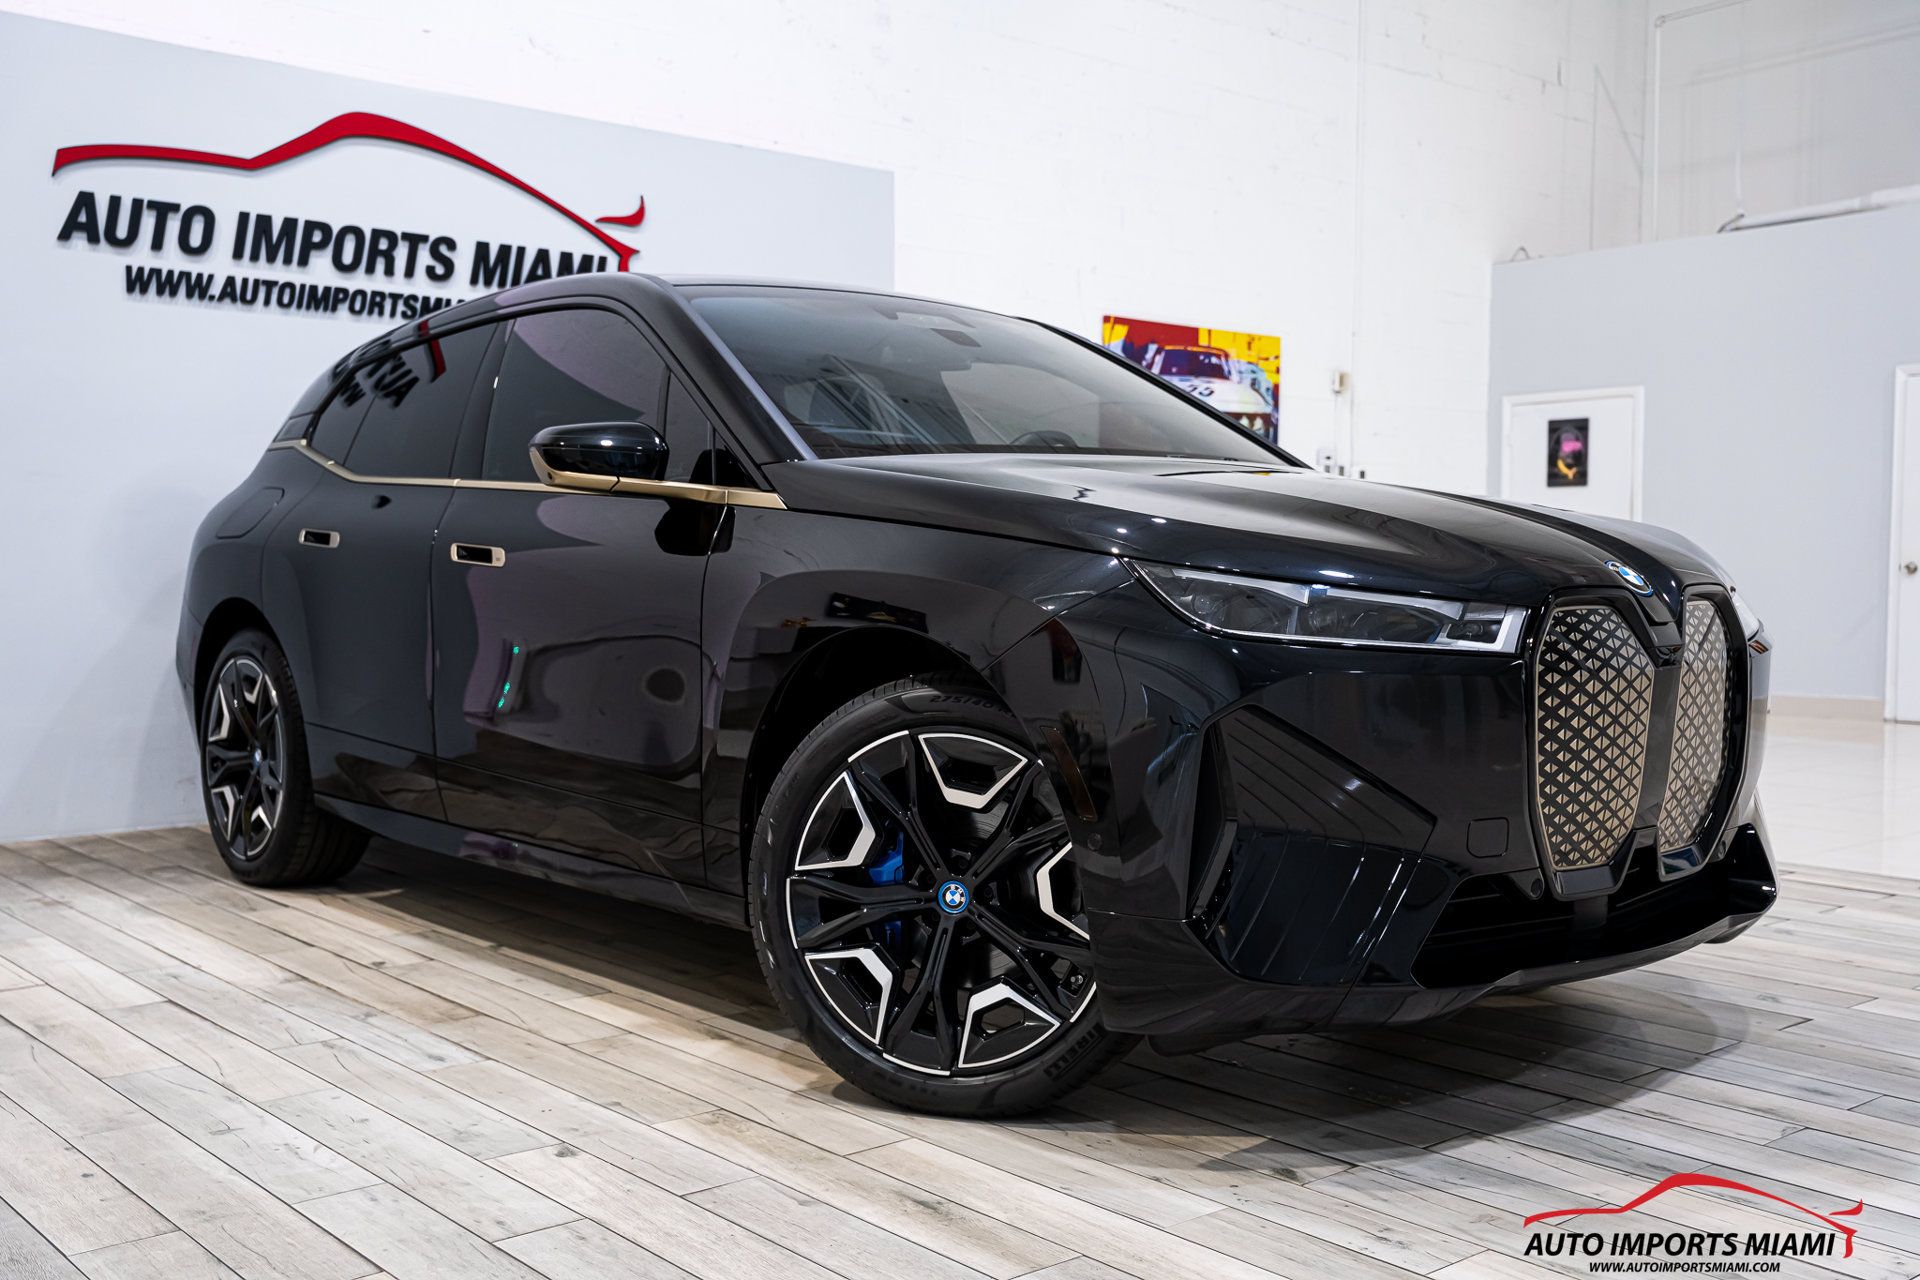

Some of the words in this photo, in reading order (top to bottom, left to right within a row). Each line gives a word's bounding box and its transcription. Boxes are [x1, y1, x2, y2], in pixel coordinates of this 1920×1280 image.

[56, 190, 216, 256] AUTO
[231, 211, 457, 283] IMPORTS
[125, 264, 466, 320] WWW.AUTOIMPORTSM
